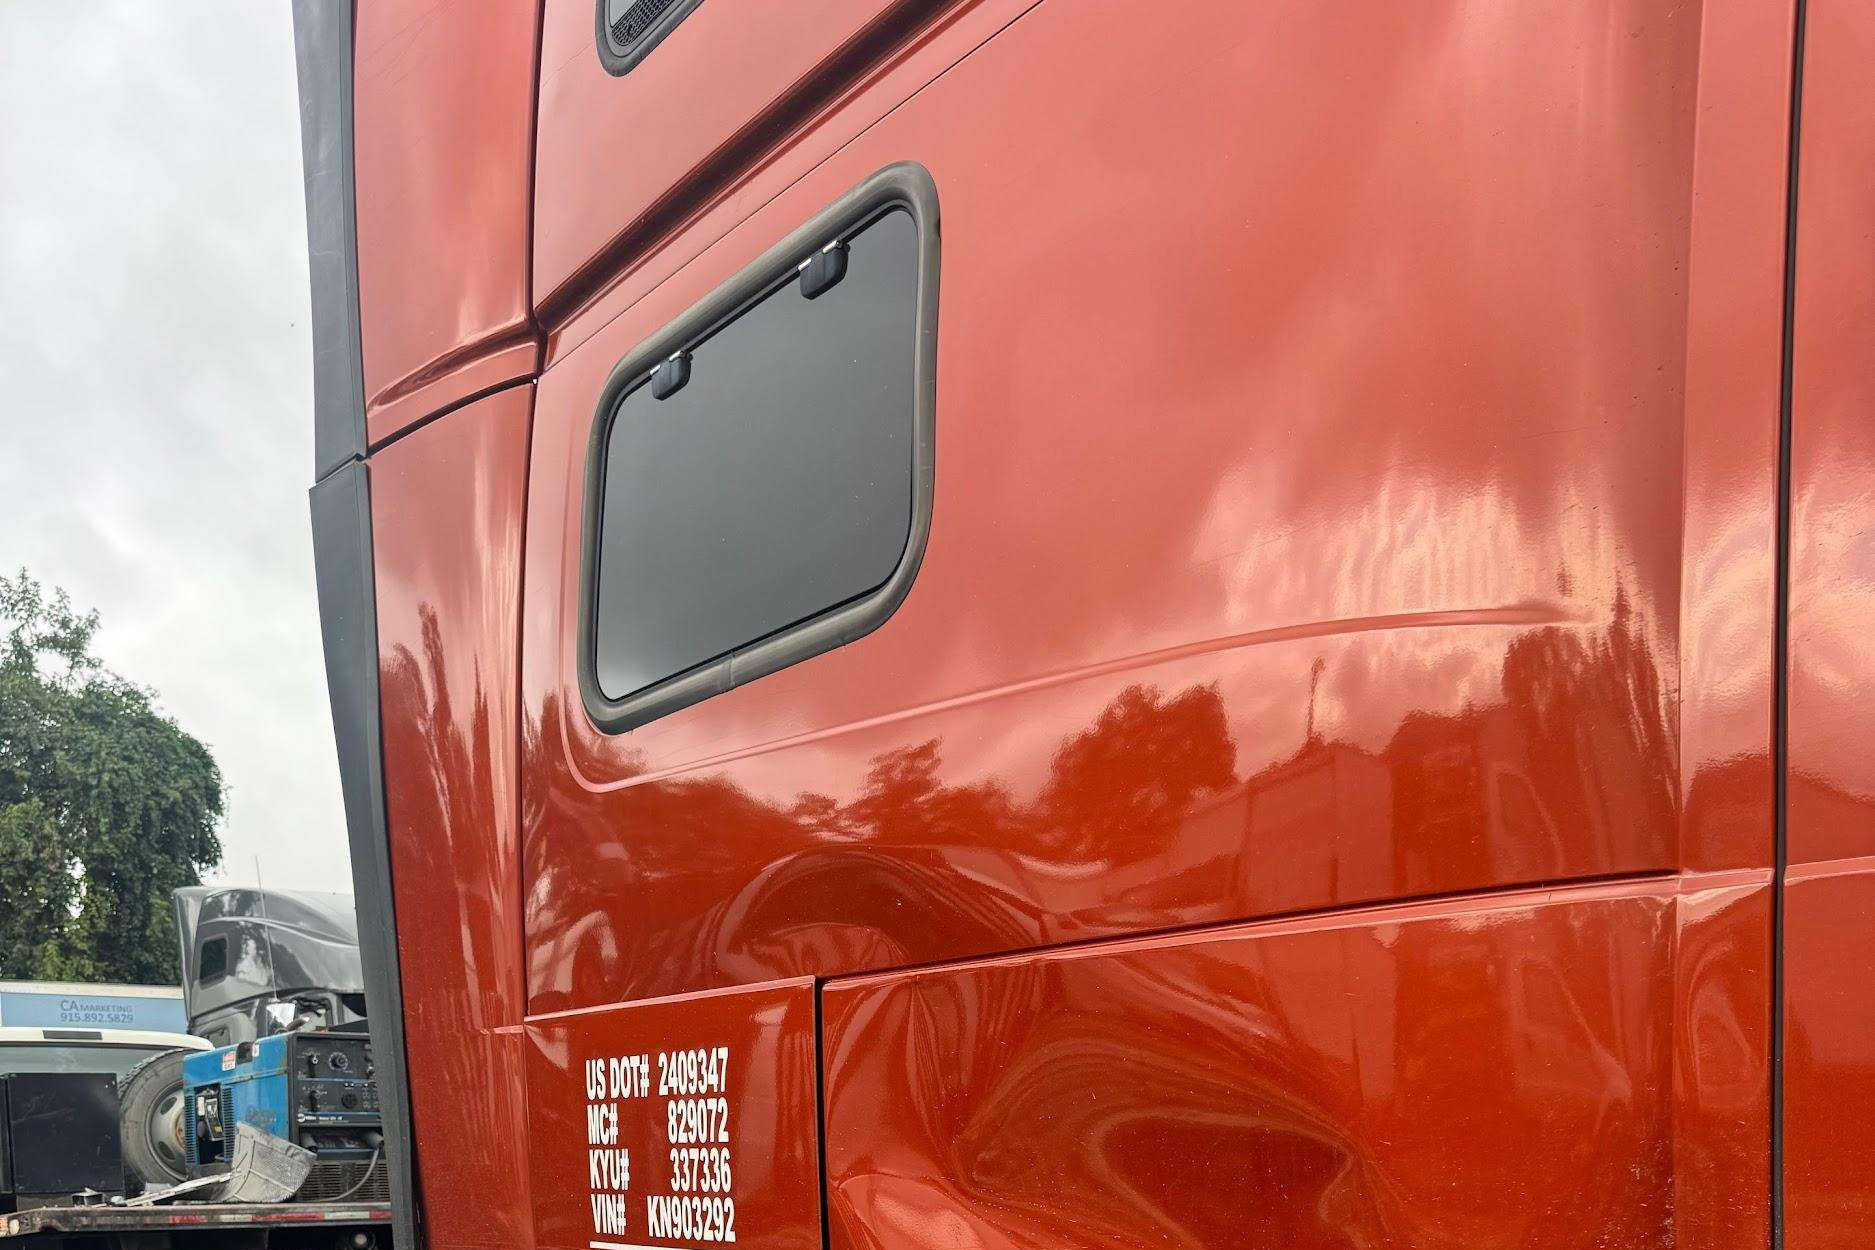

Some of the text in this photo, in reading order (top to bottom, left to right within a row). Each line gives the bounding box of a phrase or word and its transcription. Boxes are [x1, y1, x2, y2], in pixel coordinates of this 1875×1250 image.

[60, 1000, 133, 1013] CA MARKETING
[585, 1046, 729, 1100] US DOT# 2409347
[586, 1097, 730, 1145] MC# 829072
[589, 1147, 732, 1193] KYU# 337336
[590, 1193, 736, 1242] VIN# KN903292
